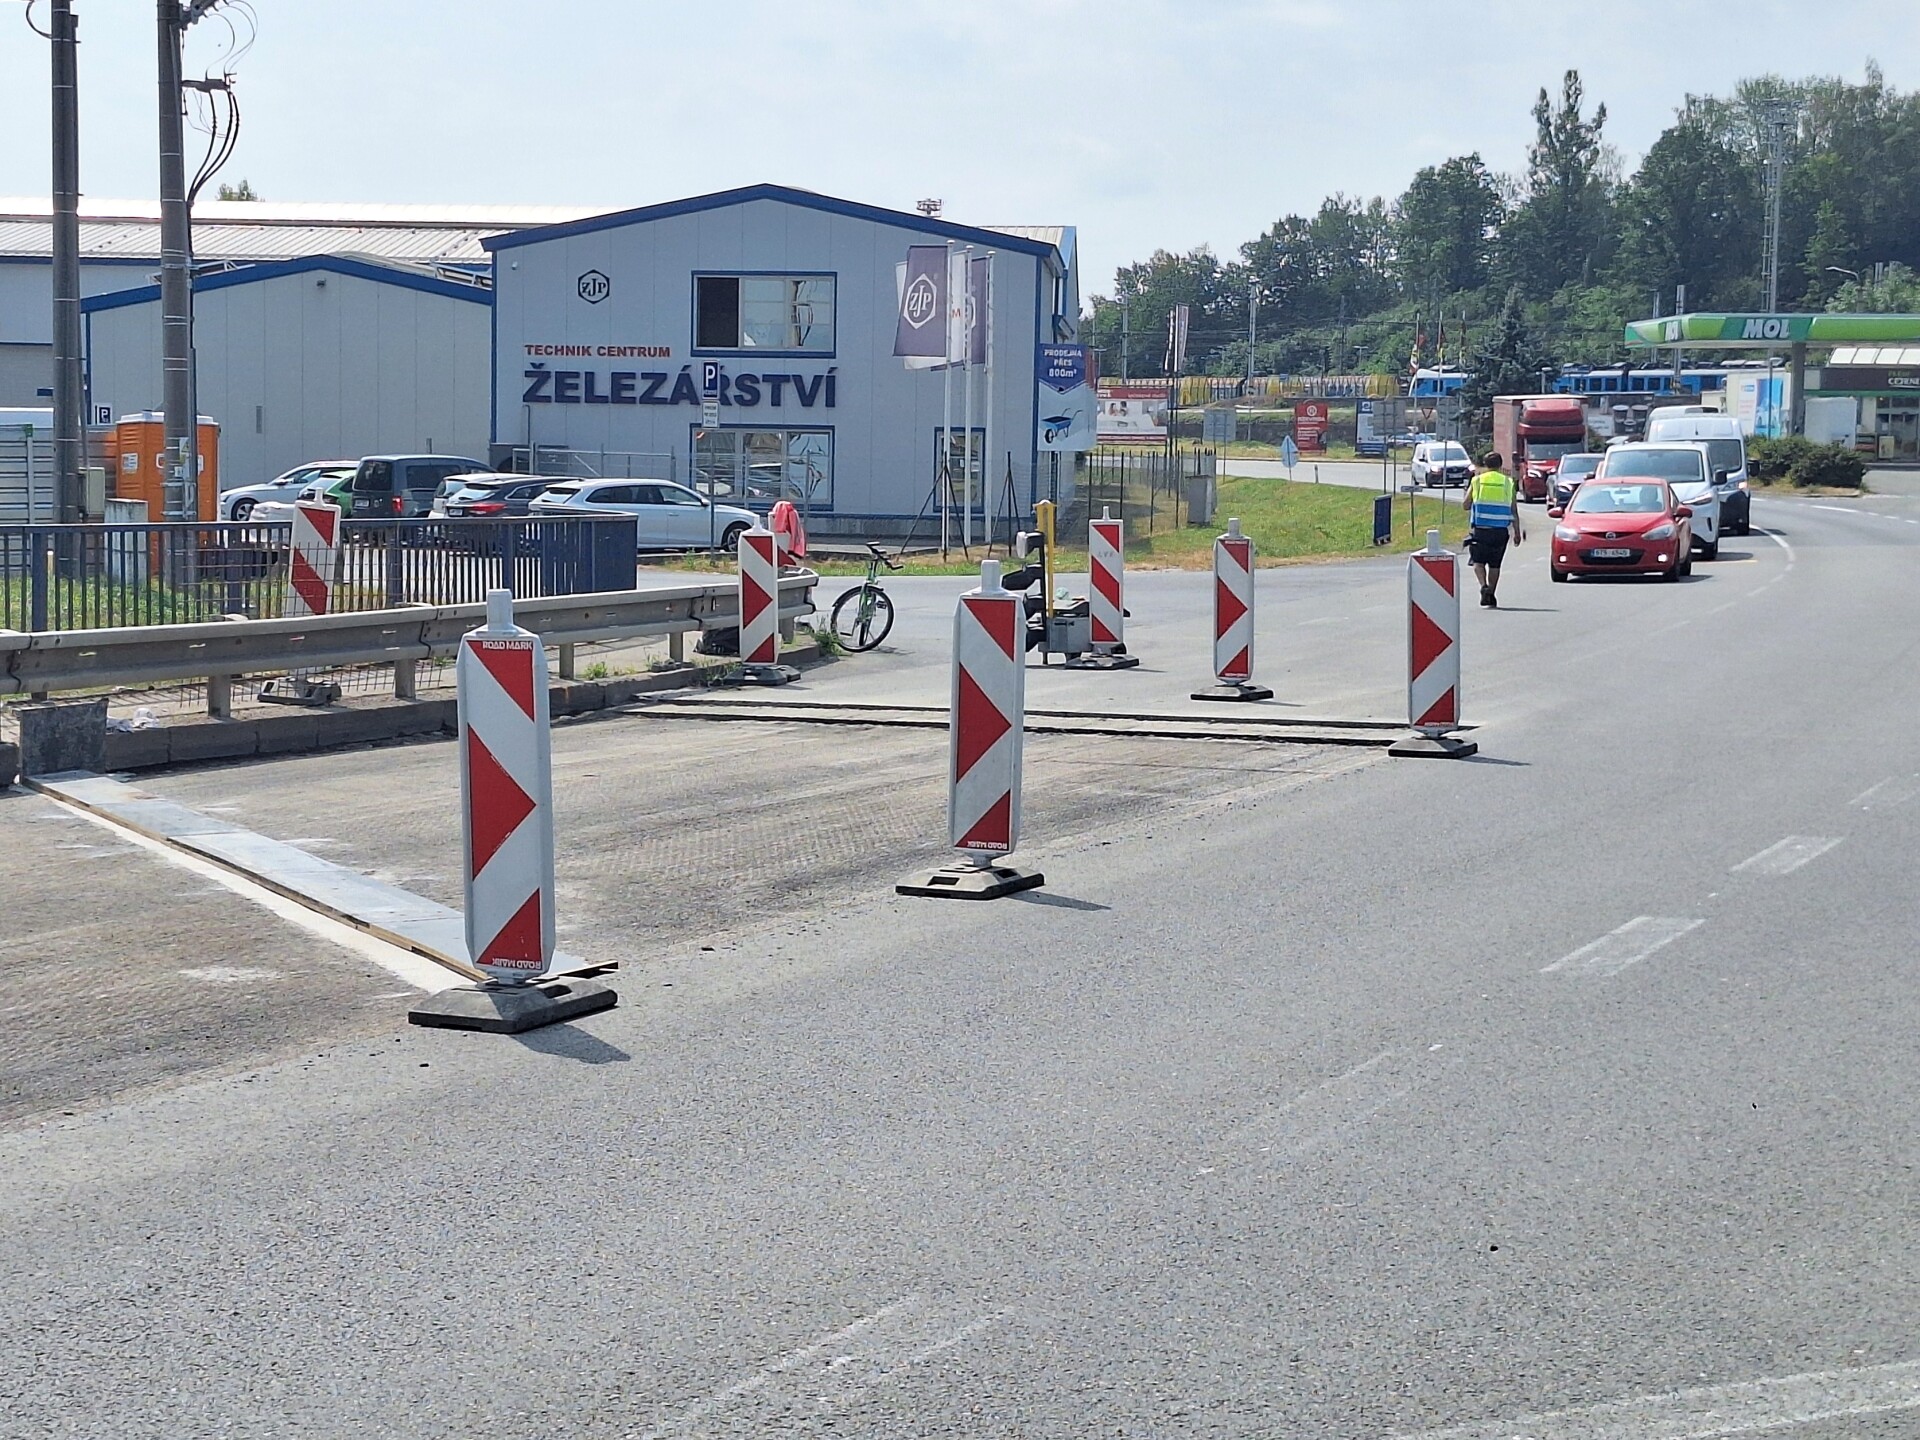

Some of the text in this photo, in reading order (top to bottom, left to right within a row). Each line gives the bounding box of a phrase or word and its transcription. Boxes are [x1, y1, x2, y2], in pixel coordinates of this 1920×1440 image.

[909, 285, 932, 318] ZJP
[1742, 318, 1790, 339] MOL
[524, 344, 671, 358] TECHNIK CENTRUM
[705, 365, 716, 388] P
[101, 408, 109, 419] P
[482, 641, 533, 650] ROAD MARK
[491, 957, 541, 970] ROAD MARK
